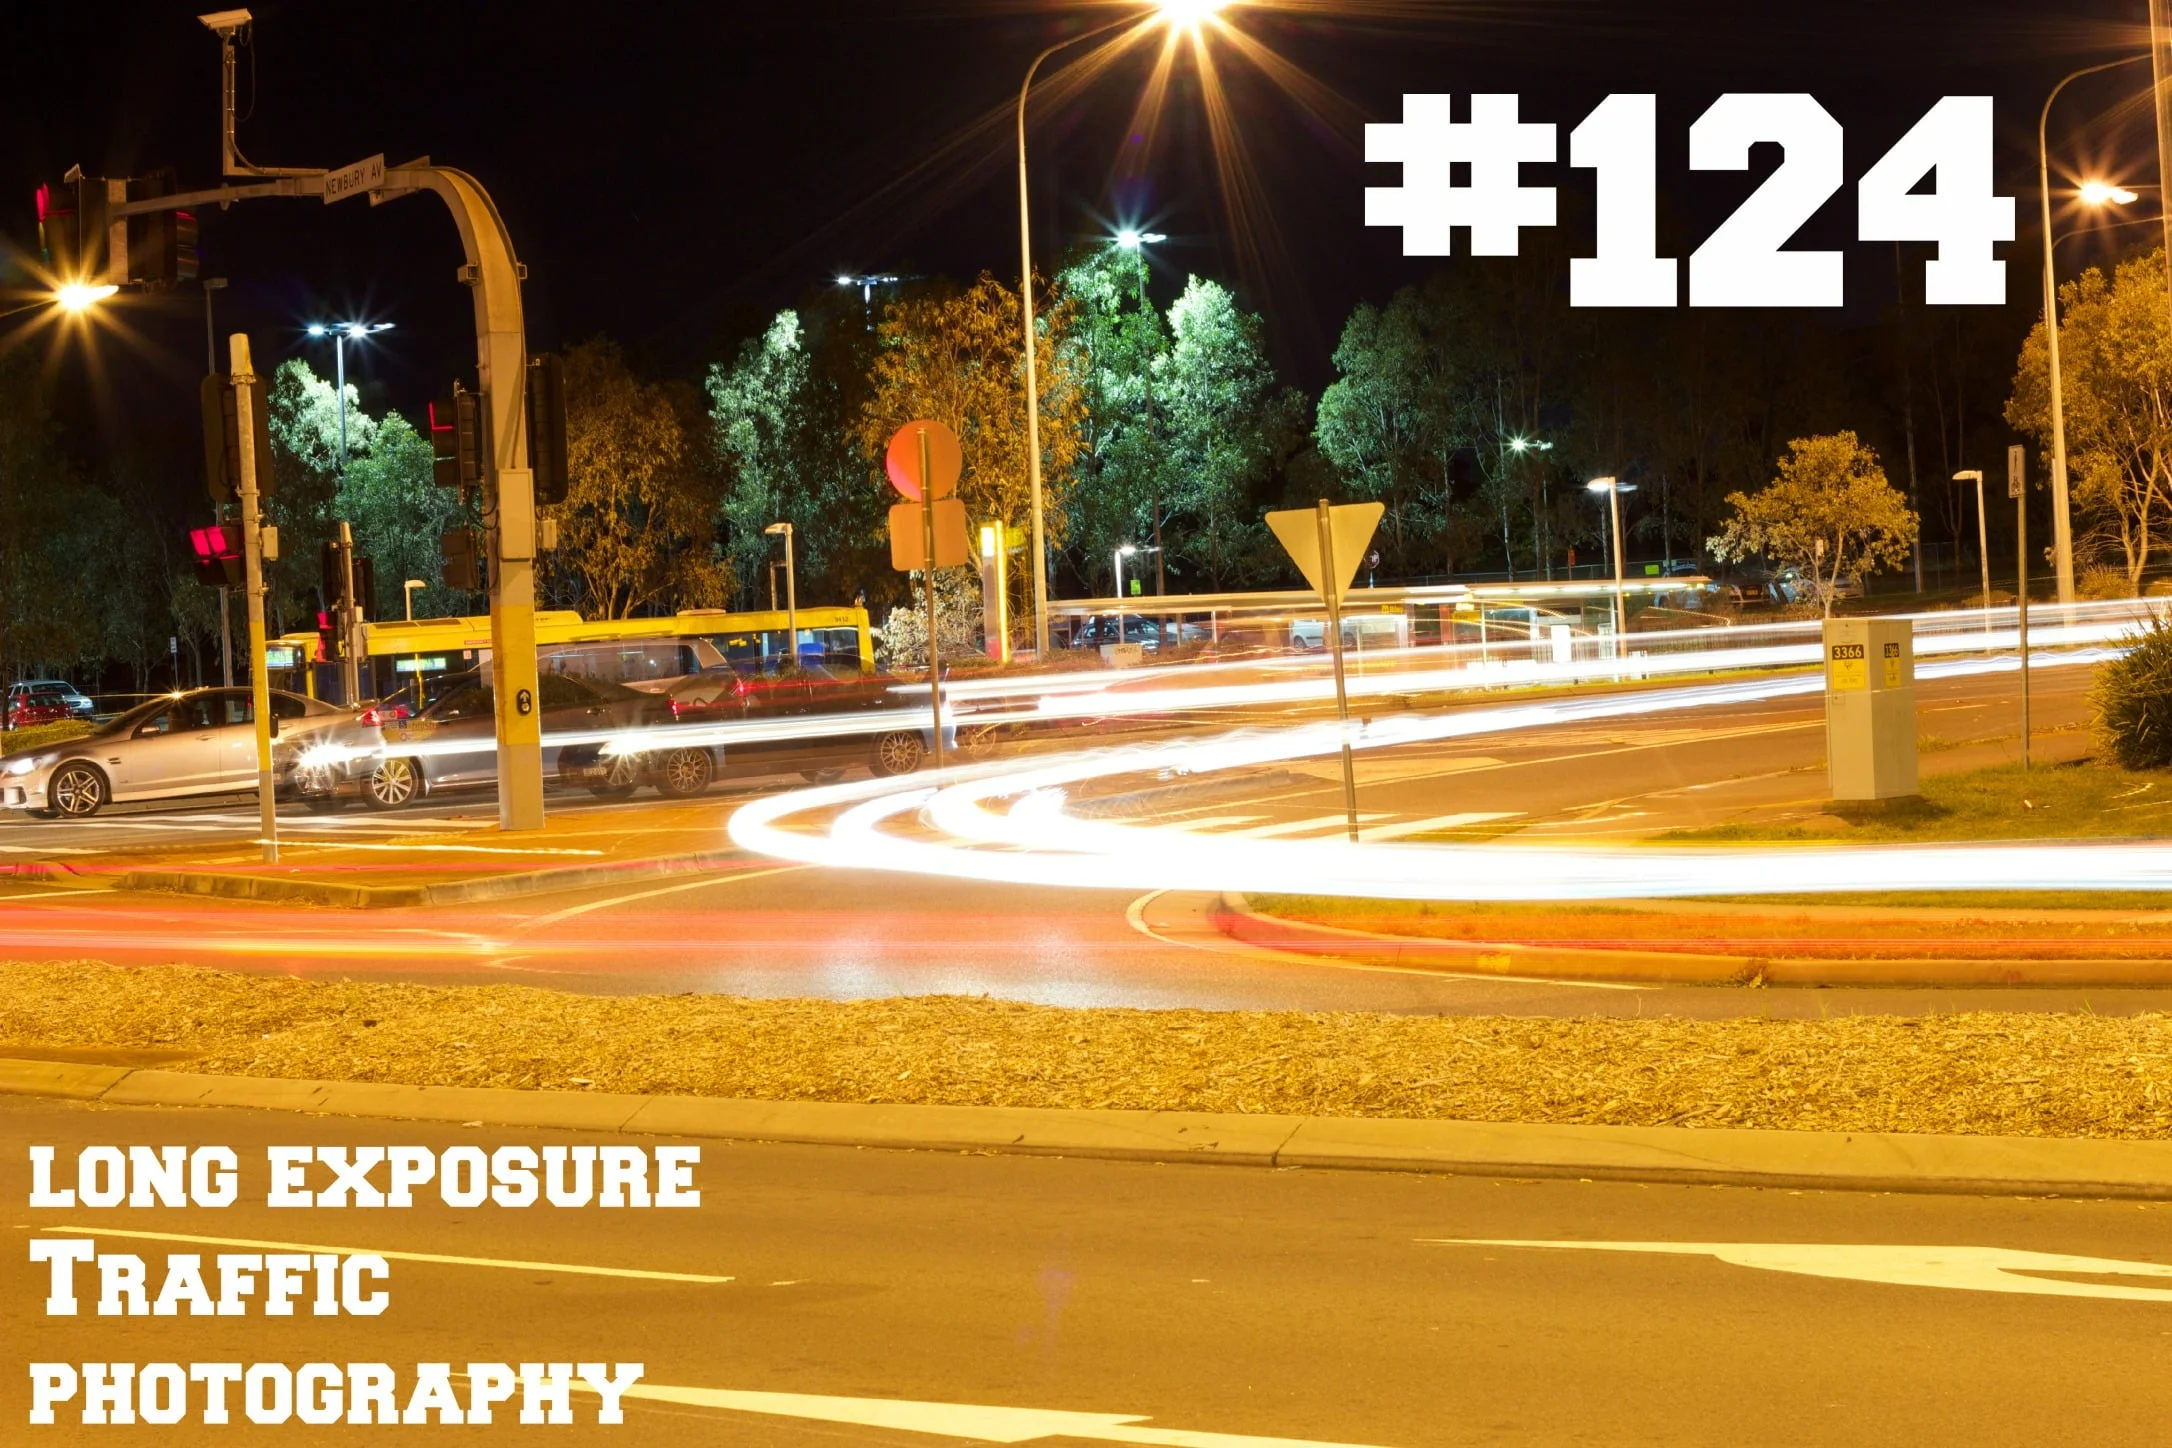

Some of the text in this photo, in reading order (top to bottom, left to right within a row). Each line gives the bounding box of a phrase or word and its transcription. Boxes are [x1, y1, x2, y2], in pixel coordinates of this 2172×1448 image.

[325, 167, 366, 196] NEWBURY
[371, 161, 382, 180] AV
[1834, 646, 1862, 658] 3366
